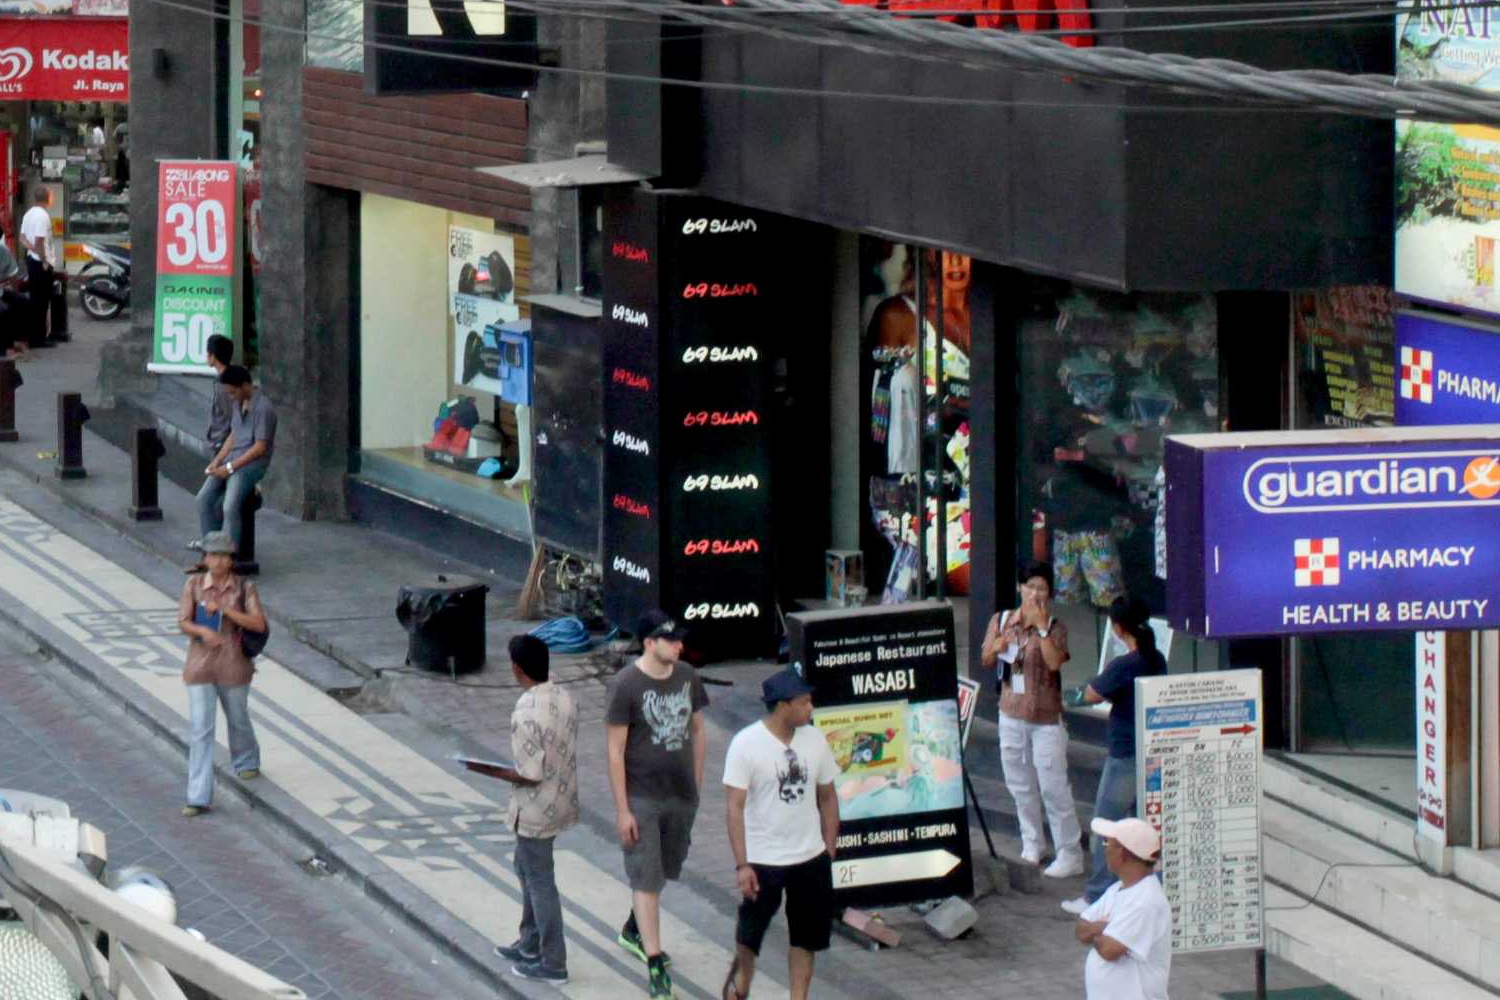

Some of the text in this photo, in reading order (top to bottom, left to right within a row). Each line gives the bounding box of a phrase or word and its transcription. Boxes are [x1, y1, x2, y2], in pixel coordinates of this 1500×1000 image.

[42, 49, 129, 71] Kodak
[93, 80, 124, 92] Raya
[165, 182, 206, 198] SALE
[165, 199, 227, 266] 30
[682, 218, 757, 234] 69 SLAM
[683, 283, 757, 298] 69 SLAM
[161, 312, 215, 364] 50
[682, 346, 758, 363] 69 SLAM
[683, 410, 758, 426] 69 SLAM
[683, 474, 758, 491] 69 SLAM
[1258, 461, 1455, 506] guardian
[684, 539, 759, 556] 69 SLAM
[1348, 546, 1475, 570] PHARMACY
[684, 602, 759, 620] 69 SLAM
[1283, 599, 1488, 625] HEALTH & BEAUTY
[815, 641, 947, 668] Japanese Restaurant
[852, 668, 915, 695] WASABI
[915, 822, 957, 839] TEMPURA
[840, 865, 859, 884] 2F
